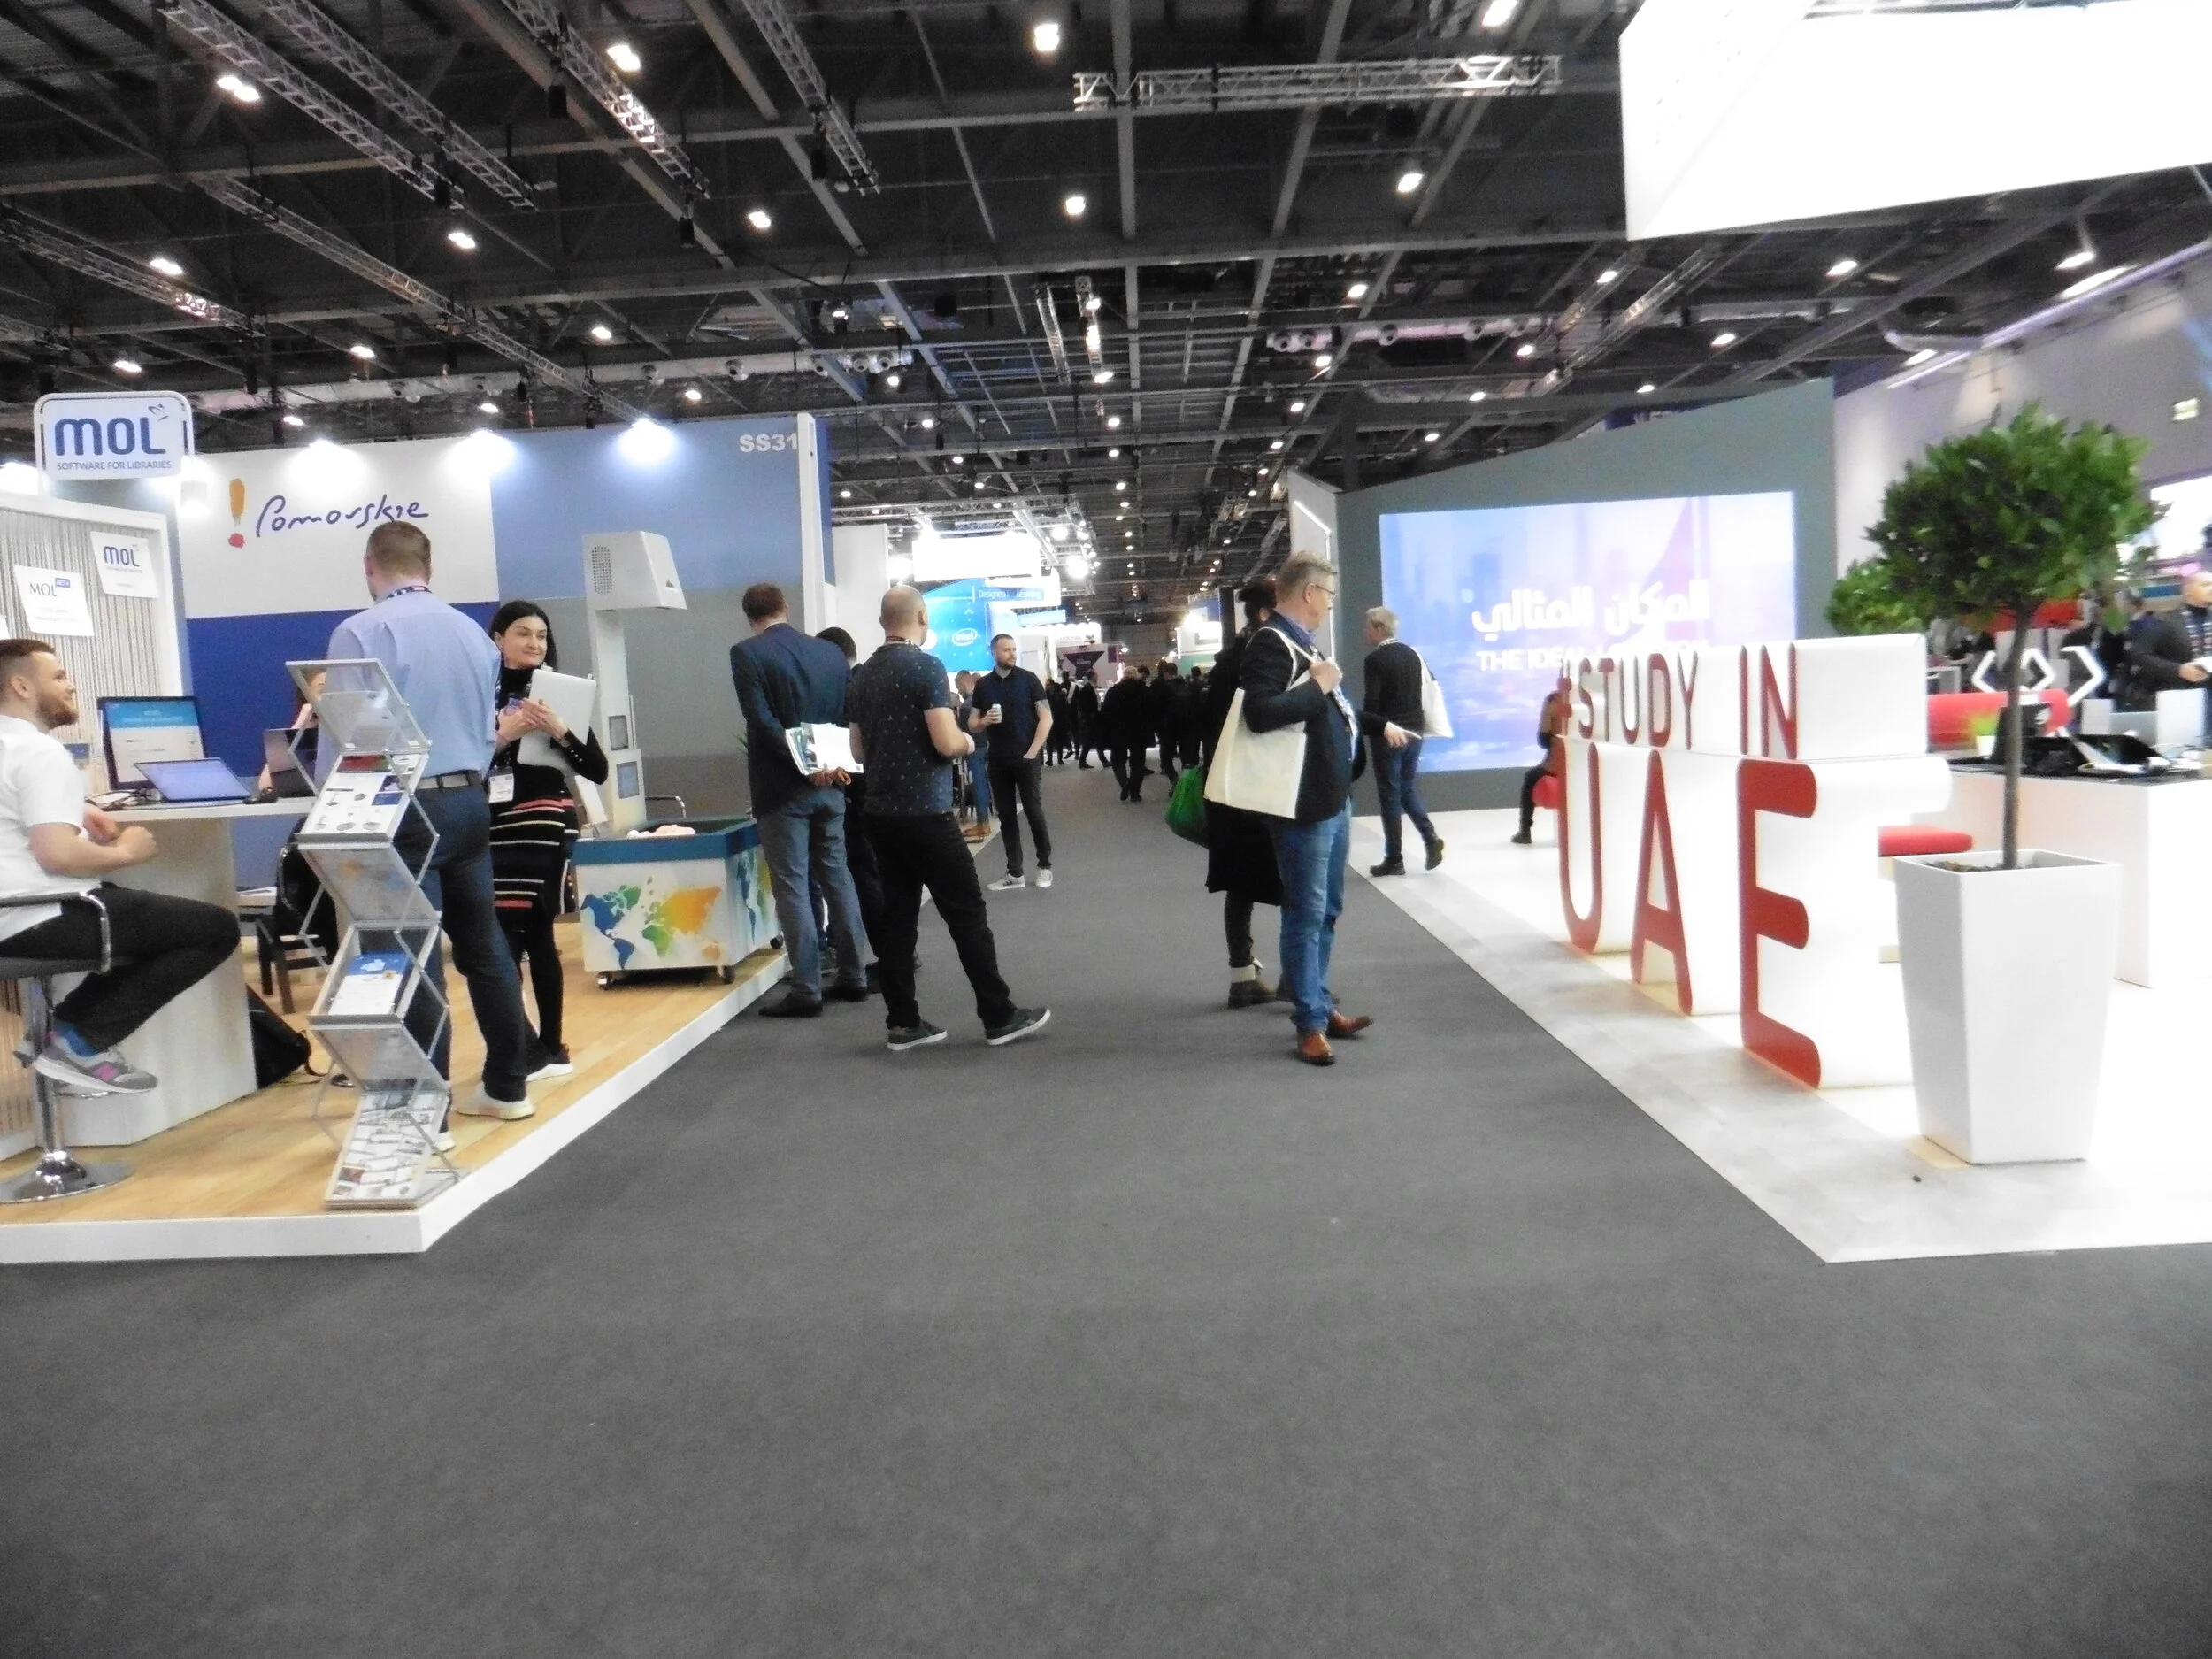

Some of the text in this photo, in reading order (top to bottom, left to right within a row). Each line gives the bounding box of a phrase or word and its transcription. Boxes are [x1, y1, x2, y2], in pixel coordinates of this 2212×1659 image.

[57, 460, 172, 471] SOFTWARE FOR LIBRARIES
[30, 581, 58, 597] MOL
[1471, 579, 1709, 641] المكان المثالي
[1476, 649, 1523, 672] THE
[1738, 641, 1798, 760] IN
[1555, 741, 1821, 1089] UAE
